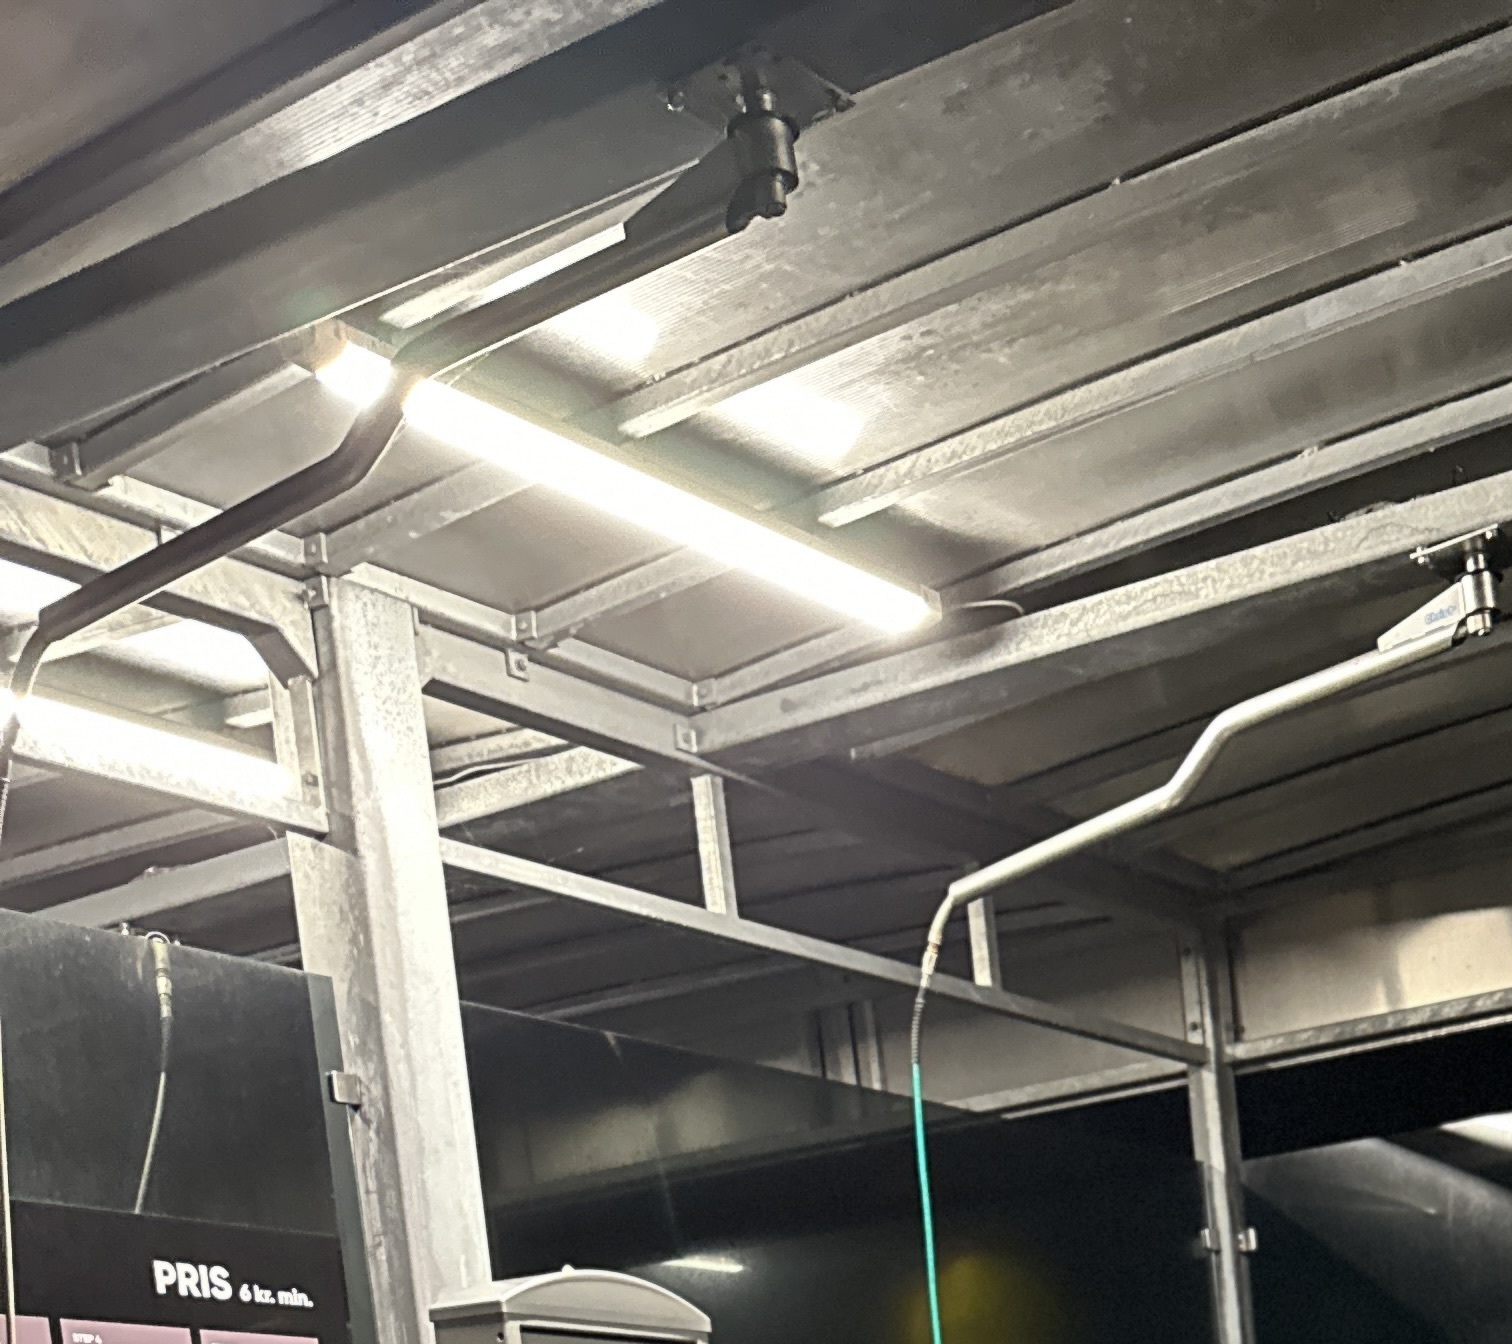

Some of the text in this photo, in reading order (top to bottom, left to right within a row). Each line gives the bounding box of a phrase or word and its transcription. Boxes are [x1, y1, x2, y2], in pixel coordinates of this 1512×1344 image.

[152, 1259, 315, 1308] PRIS 6 kr. min.
